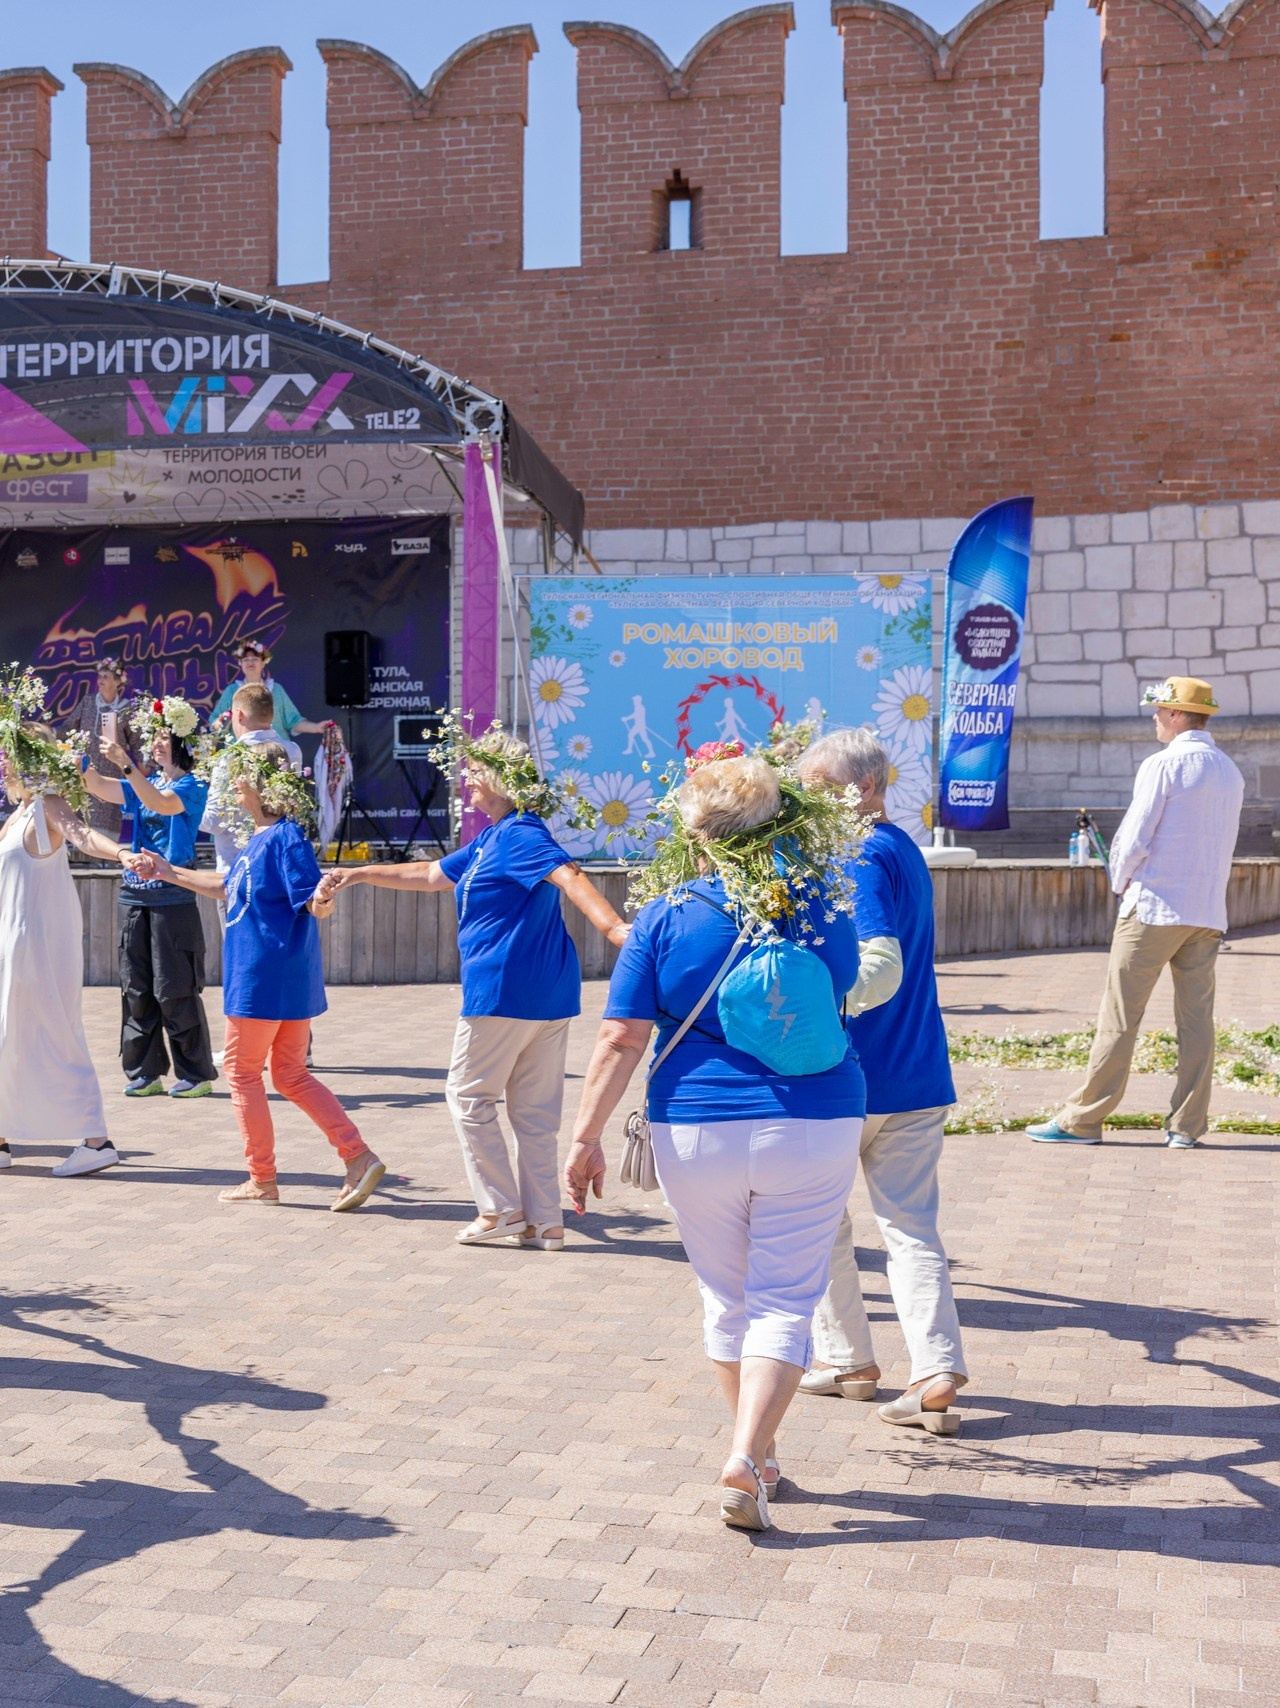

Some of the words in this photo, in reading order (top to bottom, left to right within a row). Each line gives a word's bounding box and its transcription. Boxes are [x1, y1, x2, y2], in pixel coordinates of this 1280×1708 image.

[365, 407, 421, 430] TELE2
[162, 447, 266, 463] ТЕРРИТОРИЯ
[187, 467, 301, 484] МОЛОДОСТИ
[6, 478, 72, 501] фест
[402, 542, 430, 551] БАЗА
[543, 592, 584, 600] ТУЛЬСКАЯ
[587, 592, 654, 600] РЕГИОНАЛЬНАЯ
[787, 591, 857, 599] ОБЩЕСТВЕННАЯ
[858, 591, 923, 599] ОРГАНИЗАЦИЯ
[658, 600, 709, 608] ОБЛАСТНАЯ
[766, 599, 812, 607] СЕВЕРНОЙ
[622, 617, 839, 645] РОМАШКОВЫЙ
[663, 646, 805, 672] ХОРОВОД
[373, 666, 411, 678] ТУЛА,
[947, 681, 1017, 707] СЕВЕРНАЯ
[951, 711, 1004, 737] ХОДЬБА
